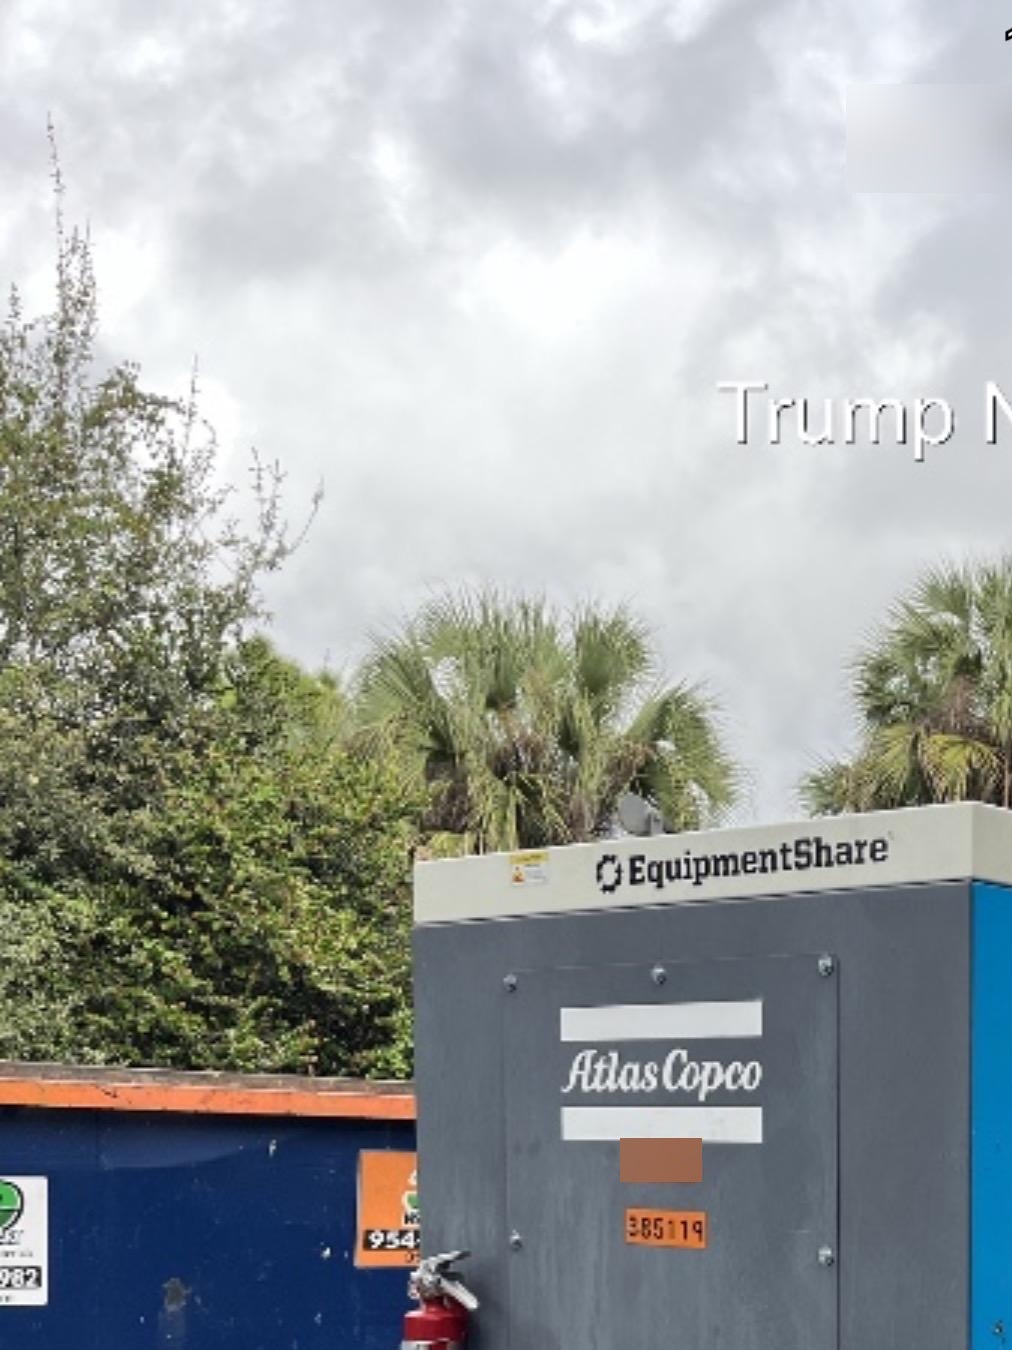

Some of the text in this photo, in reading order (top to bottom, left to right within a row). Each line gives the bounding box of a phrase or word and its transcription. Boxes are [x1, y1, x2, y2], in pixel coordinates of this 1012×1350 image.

[629, 837, 889, 888] EquipmentShare
[560, 1047, 764, 1102] Atlas Copco
